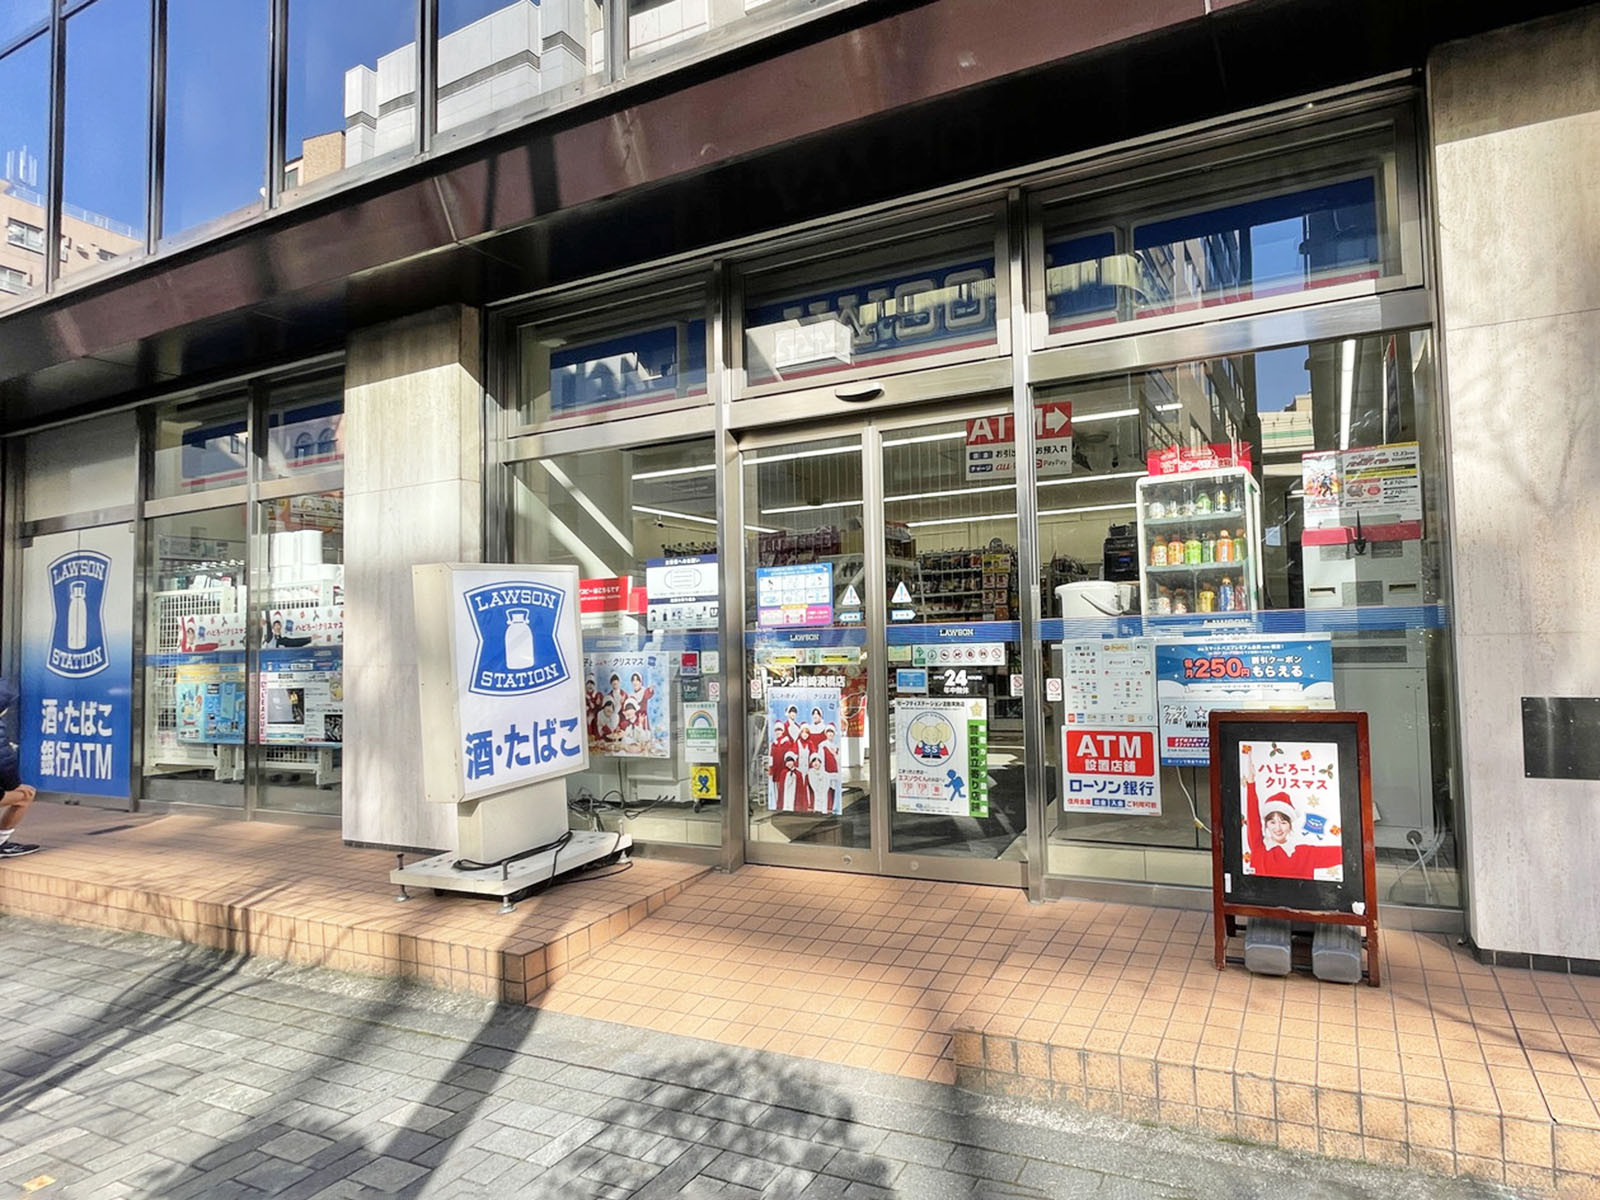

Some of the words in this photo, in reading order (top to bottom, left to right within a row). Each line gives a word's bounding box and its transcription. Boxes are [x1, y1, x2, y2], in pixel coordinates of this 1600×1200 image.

[53, 560, 106, 586] LAWSON
[474, 589, 557, 612] LAWSON
[52, 646, 103, 669] STATION
[480, 663, 560, 689] STATION
[944, 669, 968, 686] 24
[1252, 665, 1304, 678] もらえる
[42, 699, 112, 736] 酒・たばこ
[466, 717, 580, 779] 酒・たばこ
[1076, 735, 1142, 758] ATM
[40, 740, 112, 780] 銀行ATM
[1084, 758, 1136, 773] 設置店舗
[1258, 763, 1316, 776] ハピろー!
[1069, 780, 1154, 796] ローソン銀行
[1265, 776, 1328, 790] クリスマス
